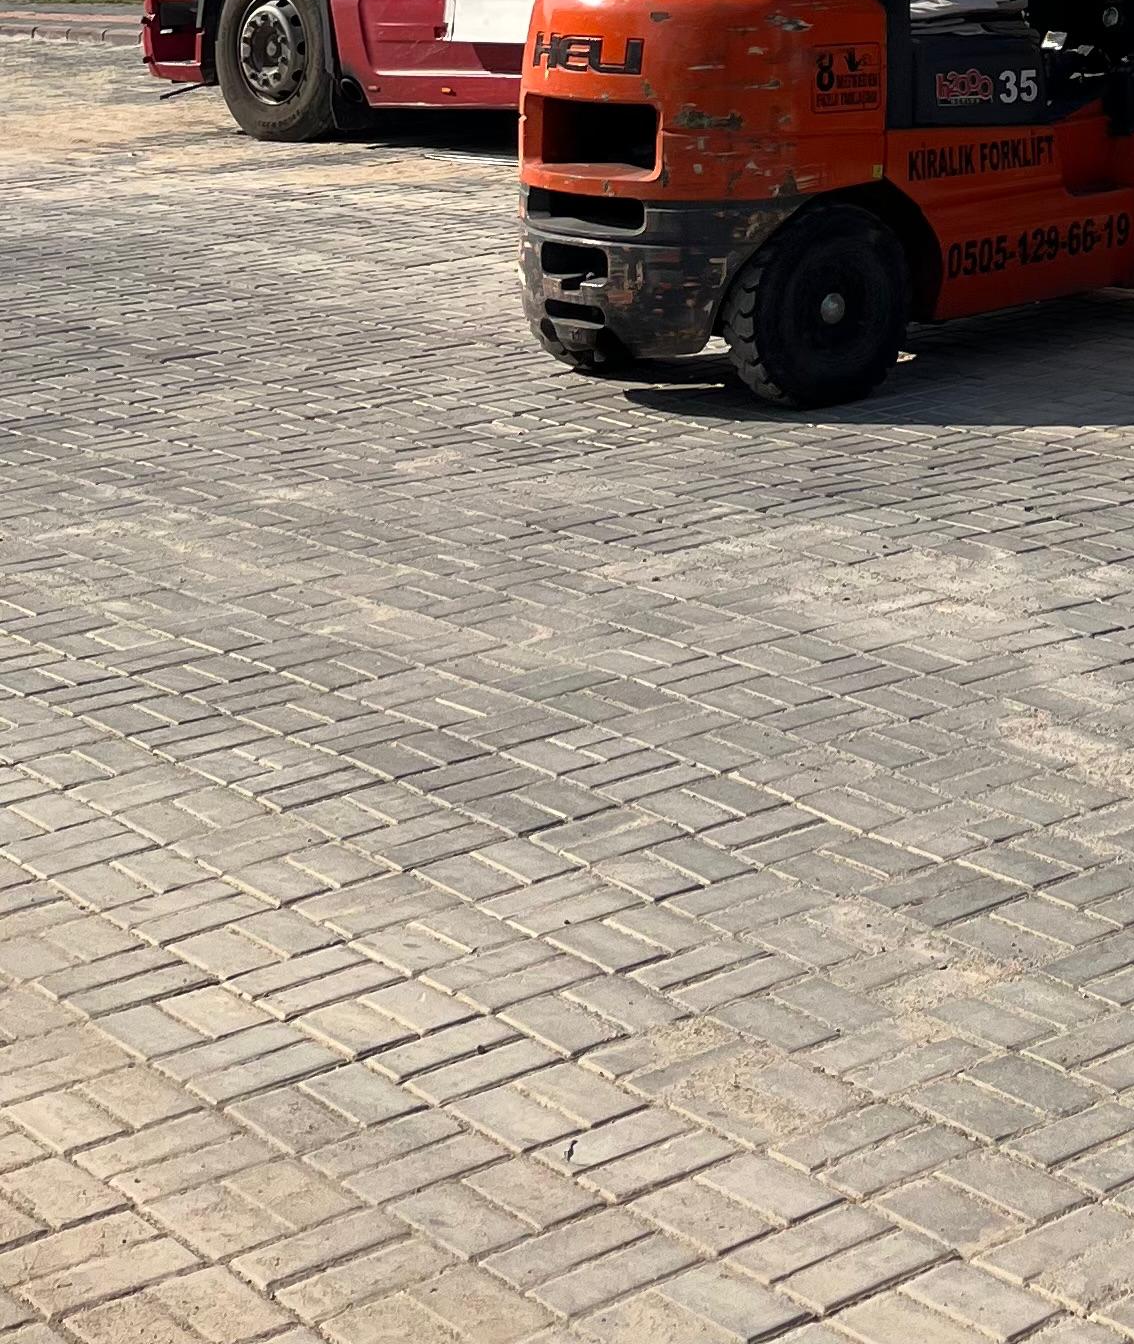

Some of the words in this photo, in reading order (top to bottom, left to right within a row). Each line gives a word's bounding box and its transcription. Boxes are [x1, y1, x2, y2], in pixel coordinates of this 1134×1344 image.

[533, 31, 643, 75] HELI
[999, 69, 1039, 104] 35
[908, 142, 976, 182] KİRALIK
[980, 131, 1056, 173] FORKLİFT
